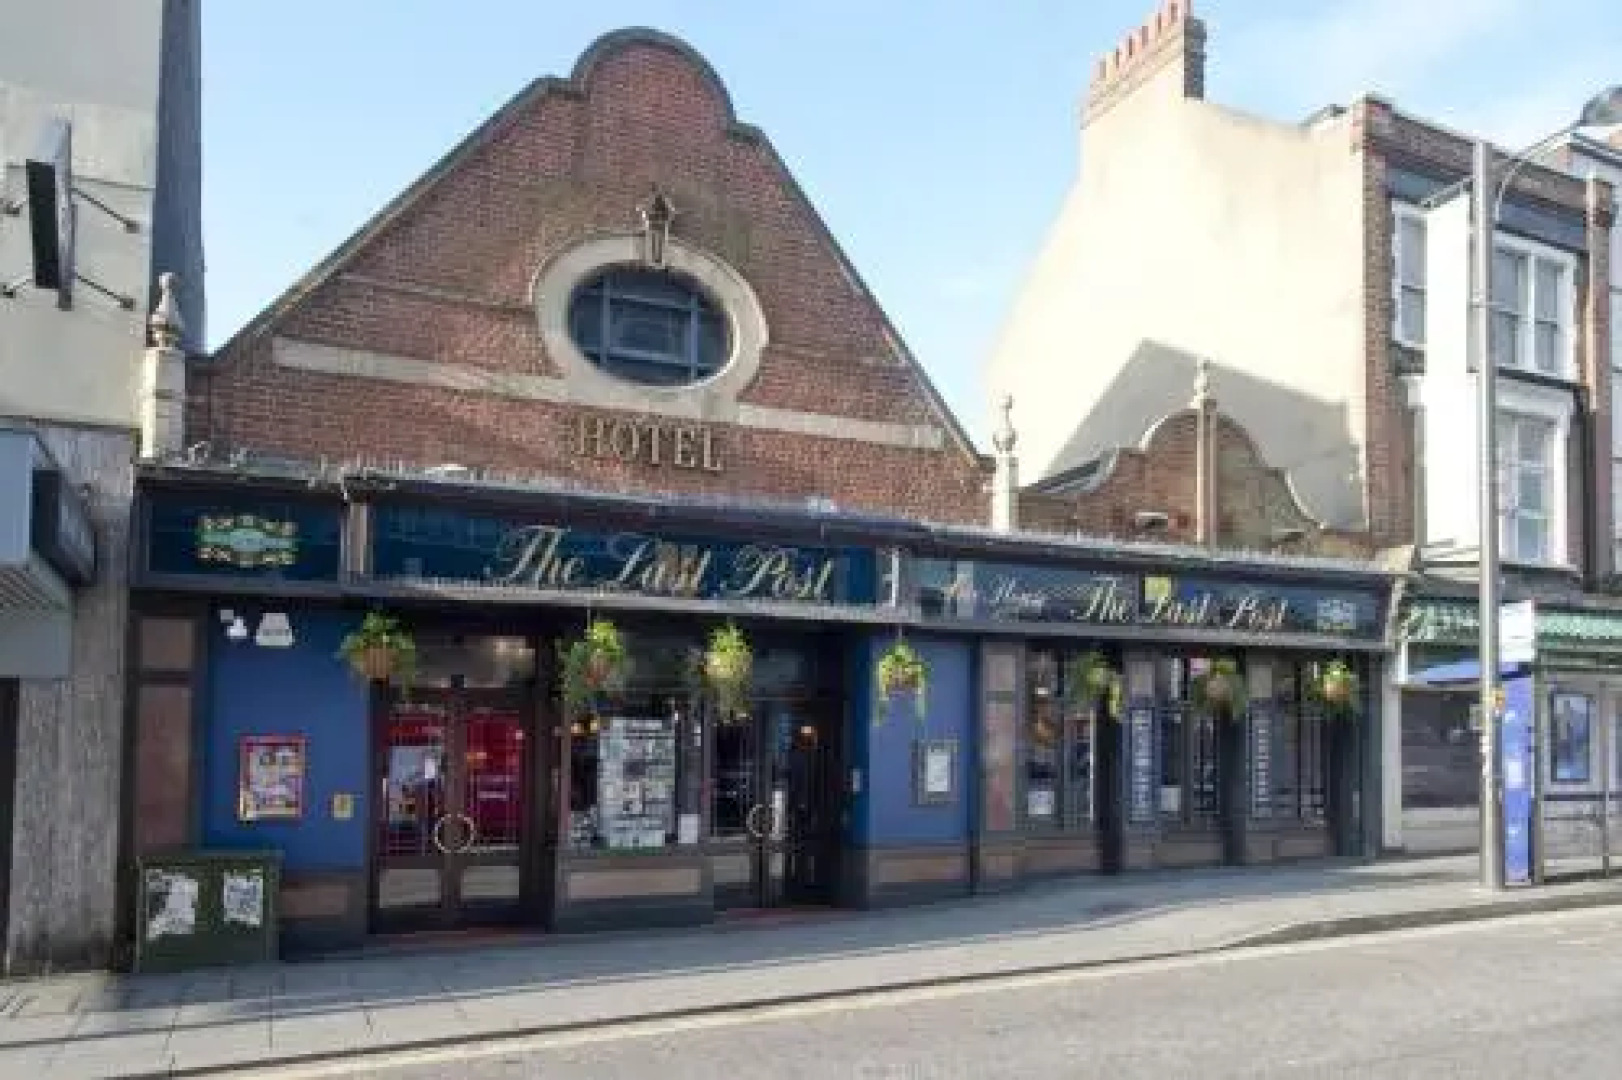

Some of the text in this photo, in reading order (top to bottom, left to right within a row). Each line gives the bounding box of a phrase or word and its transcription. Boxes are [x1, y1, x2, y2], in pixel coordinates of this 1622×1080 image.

[570, 414, 723, 472] HOTEL
[492, 525, 834, 600] The Last Post
[1073, 576, 1130, 623] The
[1143, 586, 1213, 625] Last
[1227, 594, 1289, 631] Post
